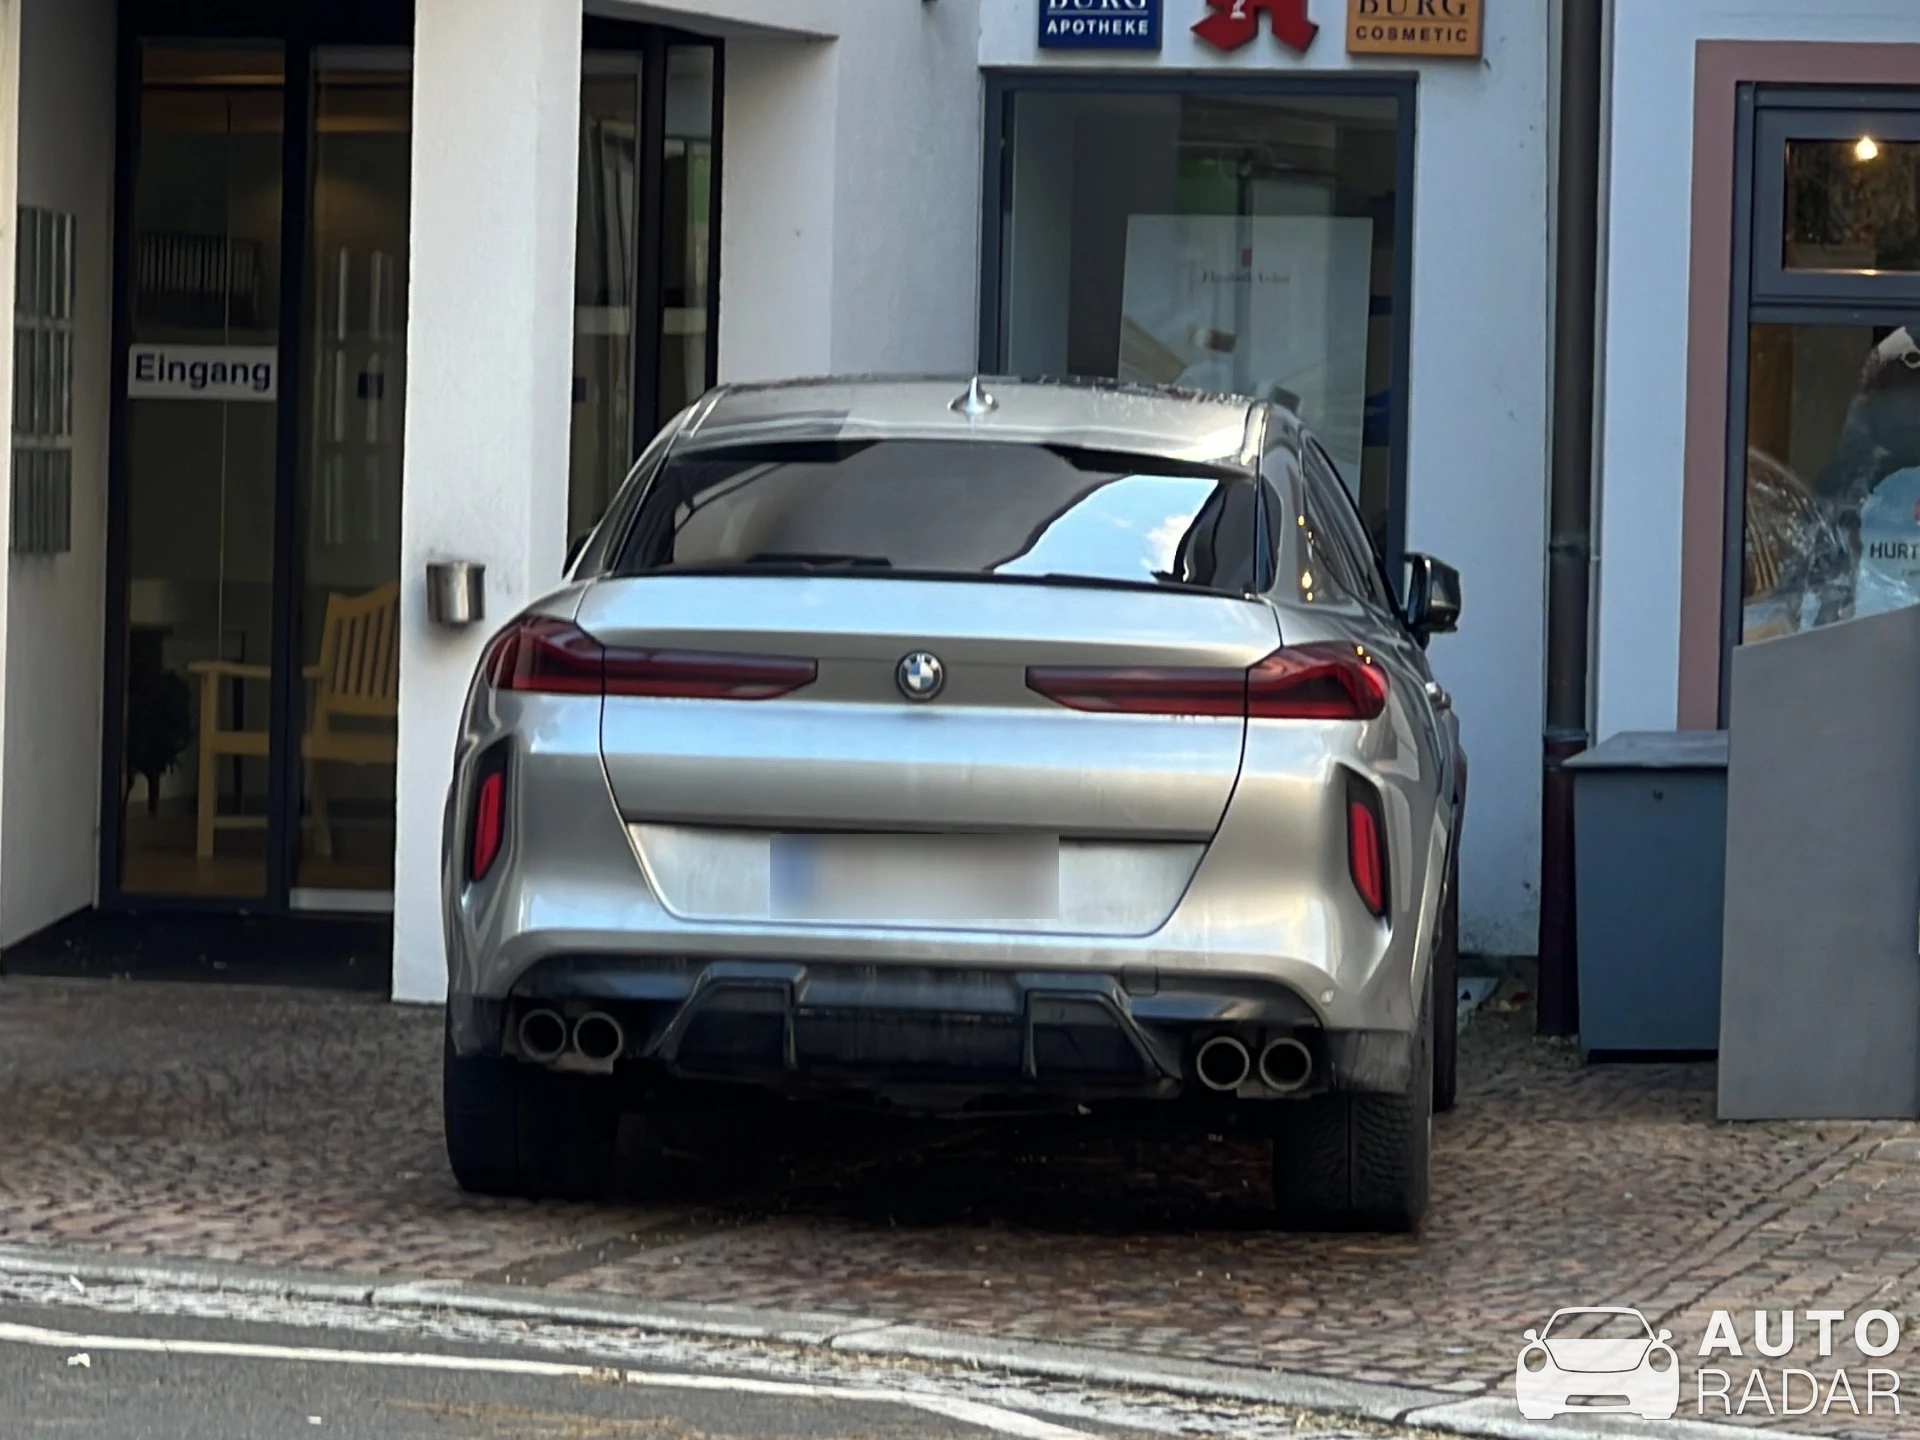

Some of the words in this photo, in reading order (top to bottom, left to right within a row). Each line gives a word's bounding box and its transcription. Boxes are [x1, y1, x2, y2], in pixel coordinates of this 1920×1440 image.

[1046, 19, 1149, 36] APOTHEKE
[1356, 25, 1468, 42] COSMETIC
[136, 353, 271, 393] Eingang
